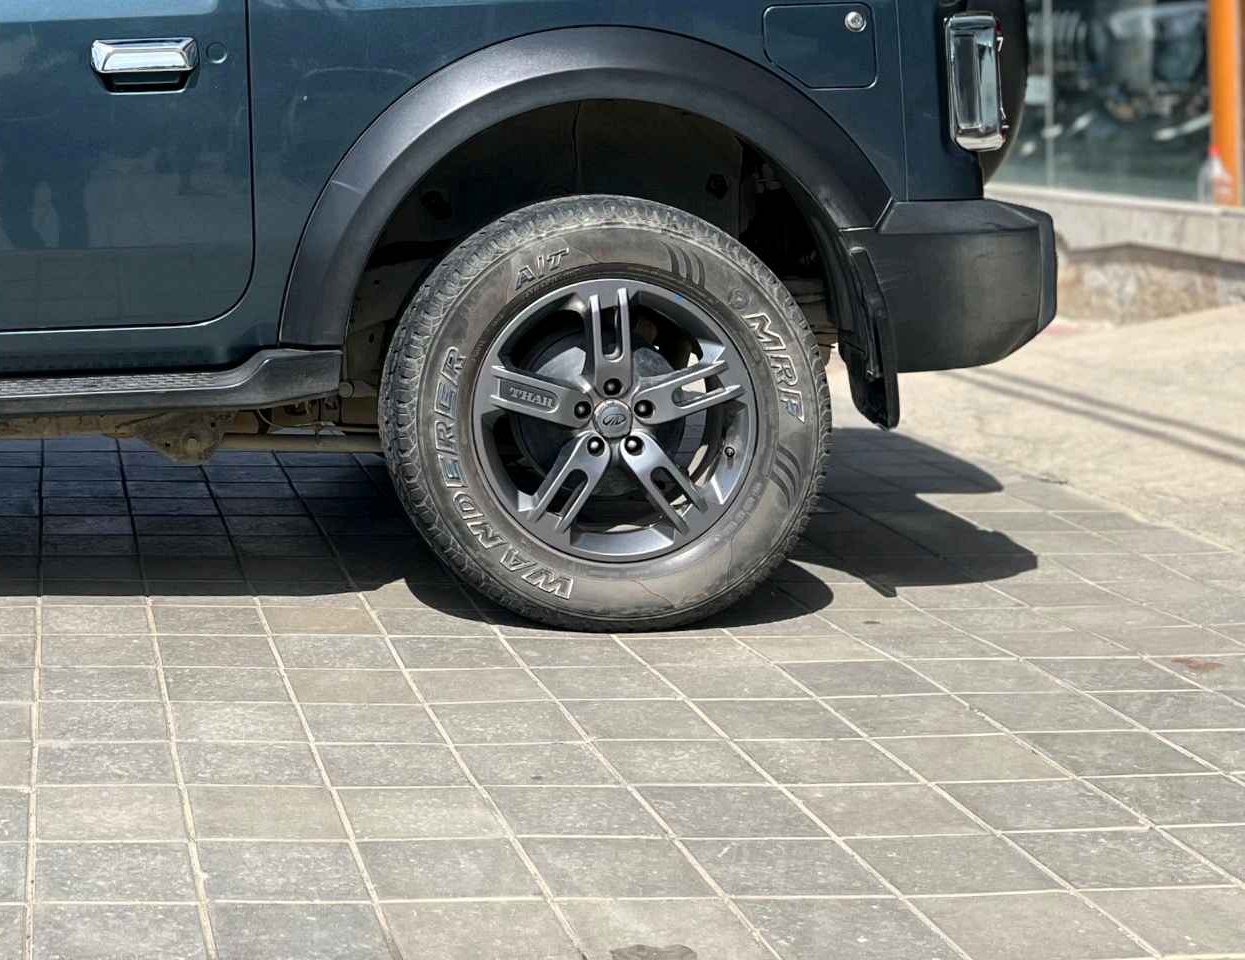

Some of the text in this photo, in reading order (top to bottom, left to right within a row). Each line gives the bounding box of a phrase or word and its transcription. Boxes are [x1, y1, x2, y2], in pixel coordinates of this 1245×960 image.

[514, 247, 570, 289] A/T
[743, 310, 806, 424] MRF
[434, 345, 575, 601] WANDERER
